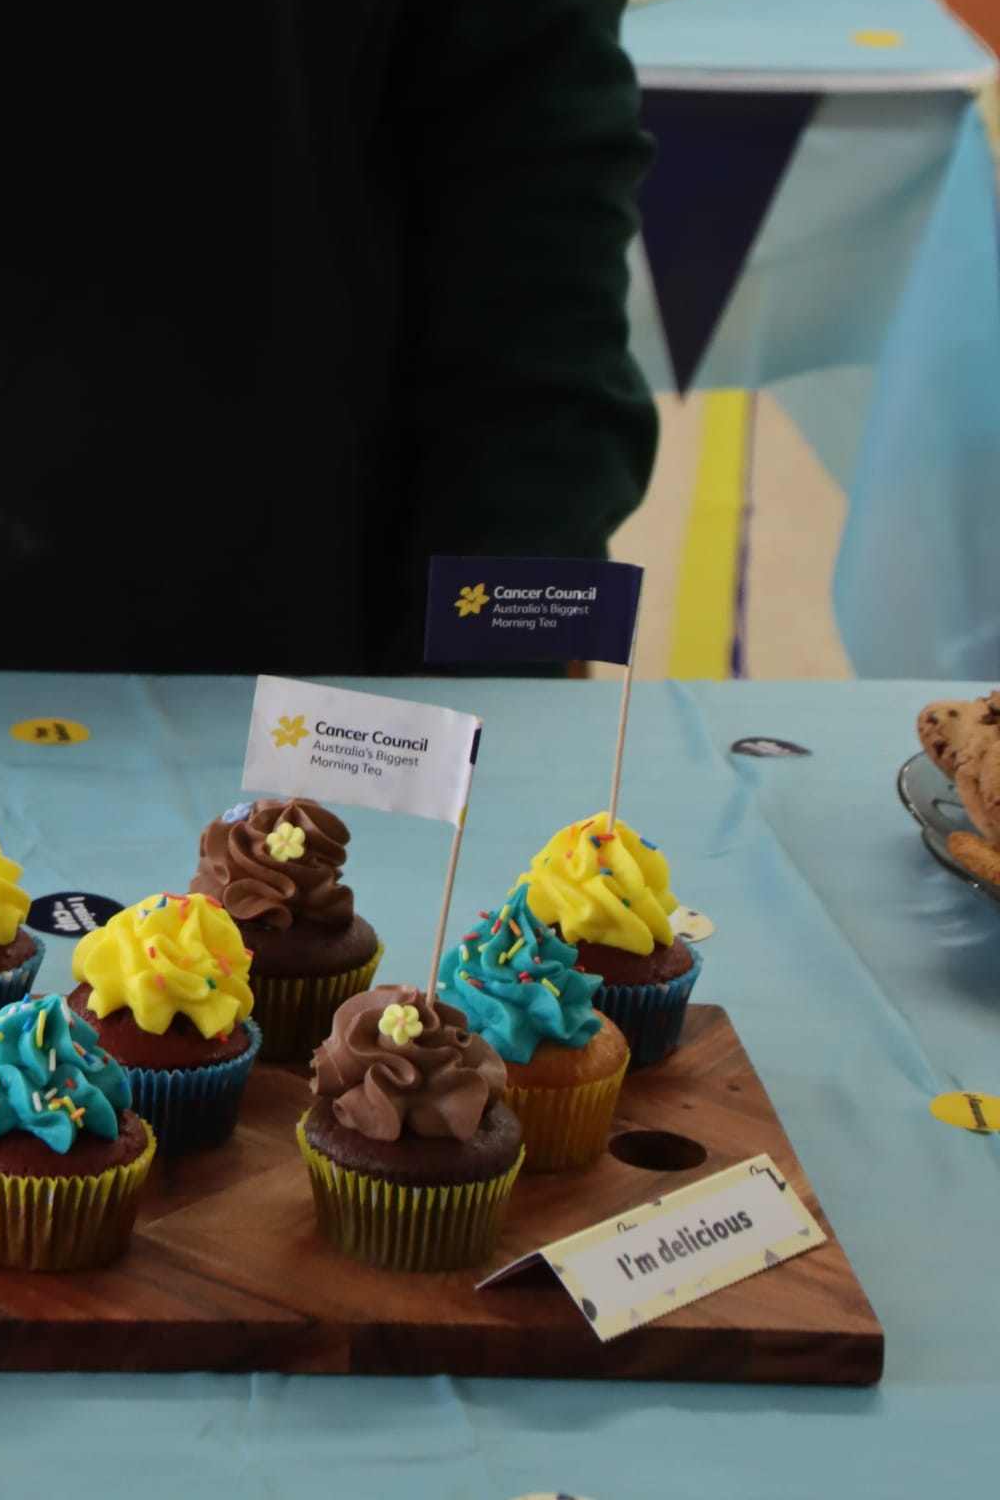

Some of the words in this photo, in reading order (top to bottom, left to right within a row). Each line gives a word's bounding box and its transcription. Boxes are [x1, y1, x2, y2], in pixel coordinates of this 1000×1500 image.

[493, 586, 543, 600] Cancer
[545, 587, 597, 600] Council
[493, 604, 548, 614] Australia's
[550, 603, 589, 617] Biggest
[492, 618, 536, 630] Morning
[539, 618, 557, 628] Tea
[315, 721, 369, 743] Cancer
[372, 731, 429, 752] Council
[312, 740, 374, 760] Australia's
[376, 750, 420, 767] Biggest
[310, 755, 359, 774] Morning
[362, 763, 383, 777] Tea
[616, 1251, 660, 1281] I'm
[658, 1210, 754, 1266] delicious
